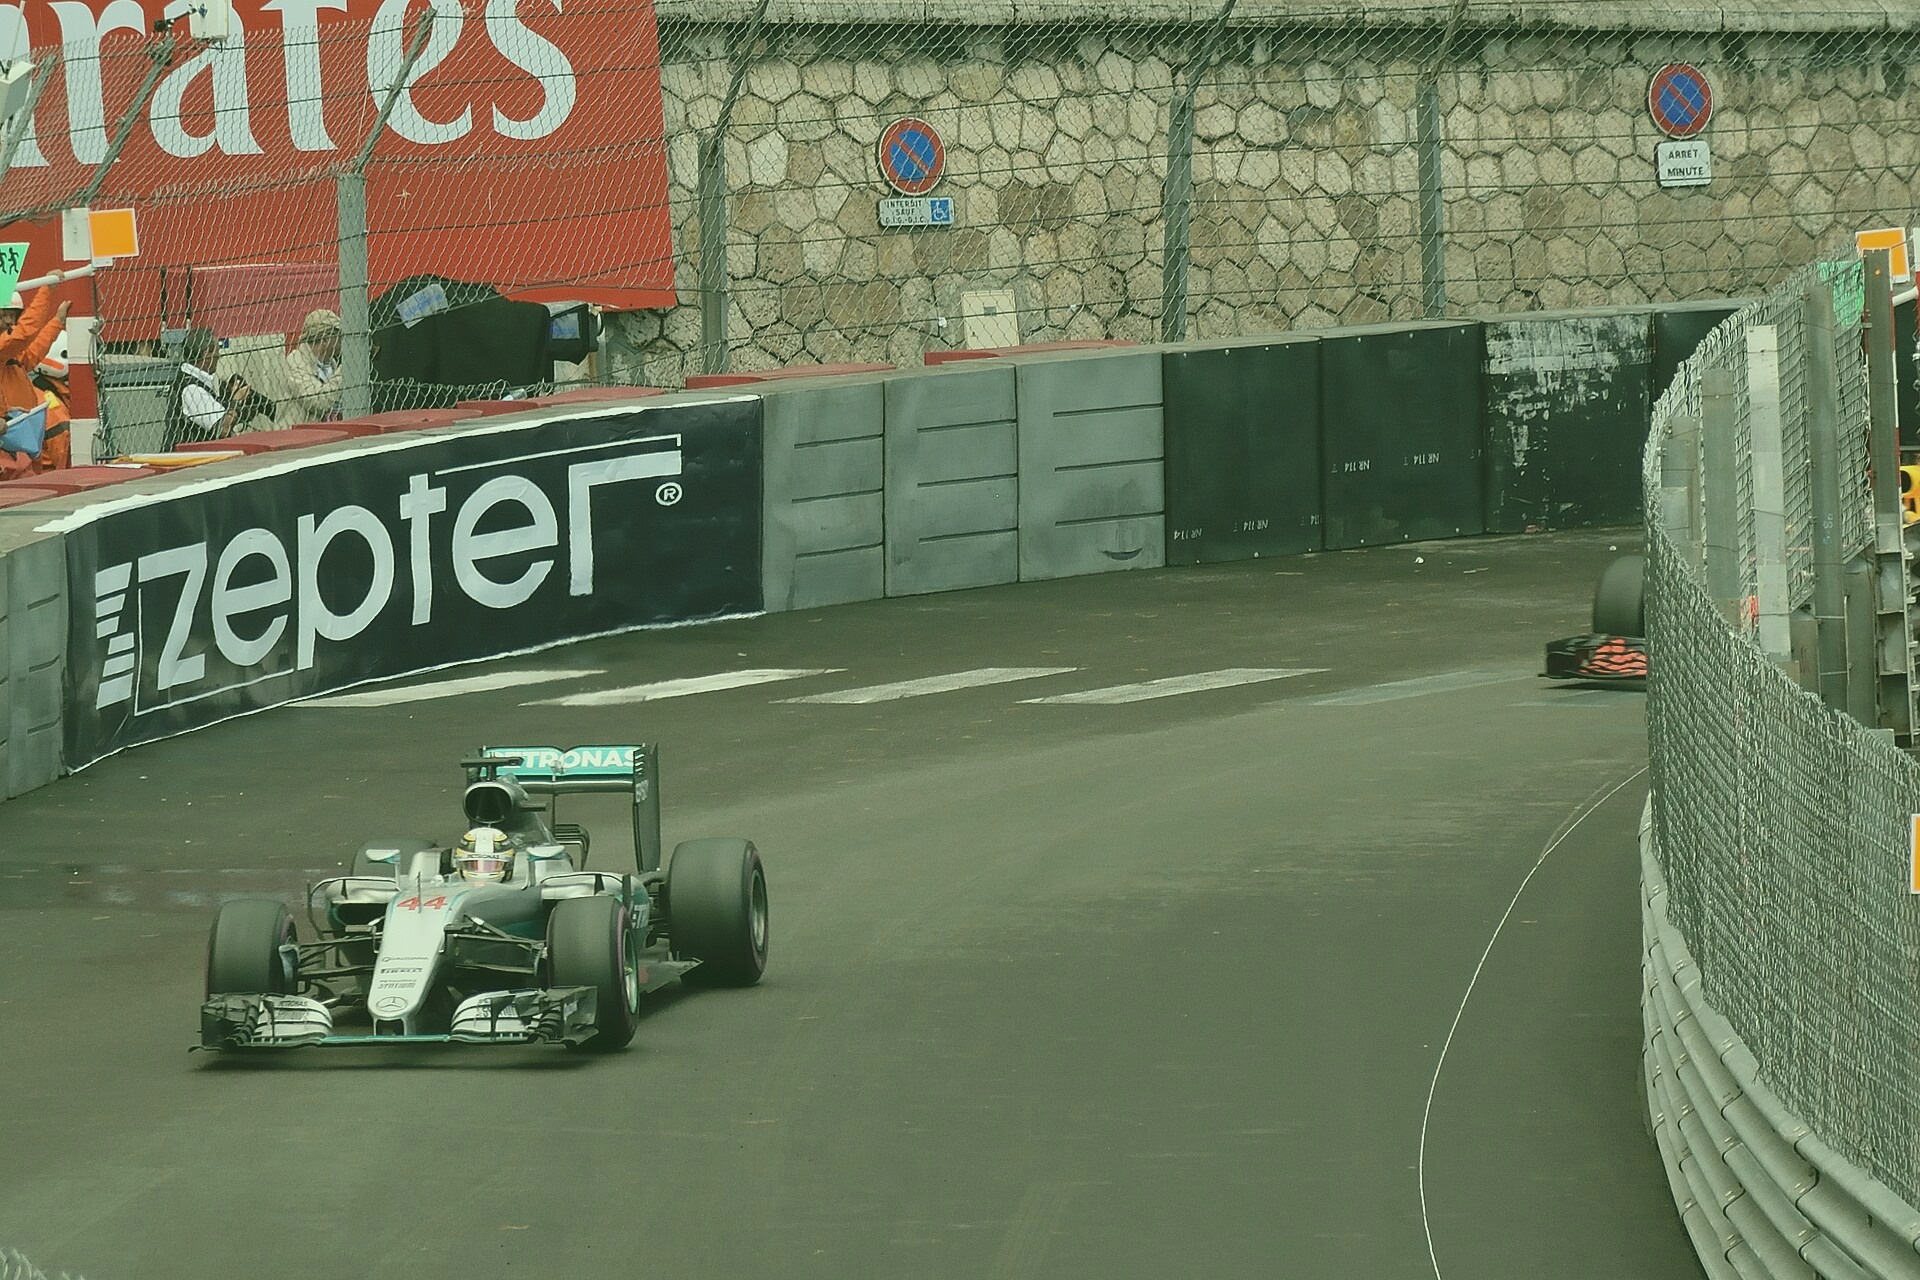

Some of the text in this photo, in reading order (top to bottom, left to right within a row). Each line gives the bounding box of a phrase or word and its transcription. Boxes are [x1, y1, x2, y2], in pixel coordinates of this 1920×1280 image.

[1668, 149, 1699, 160] ARRET
[1667, 167, 1704, 177] MINUTE
[886, 200, 922, 209] INTERDIT
[895, 208, 915, 216] SAUF
[396, 896, 448, 911] 44
